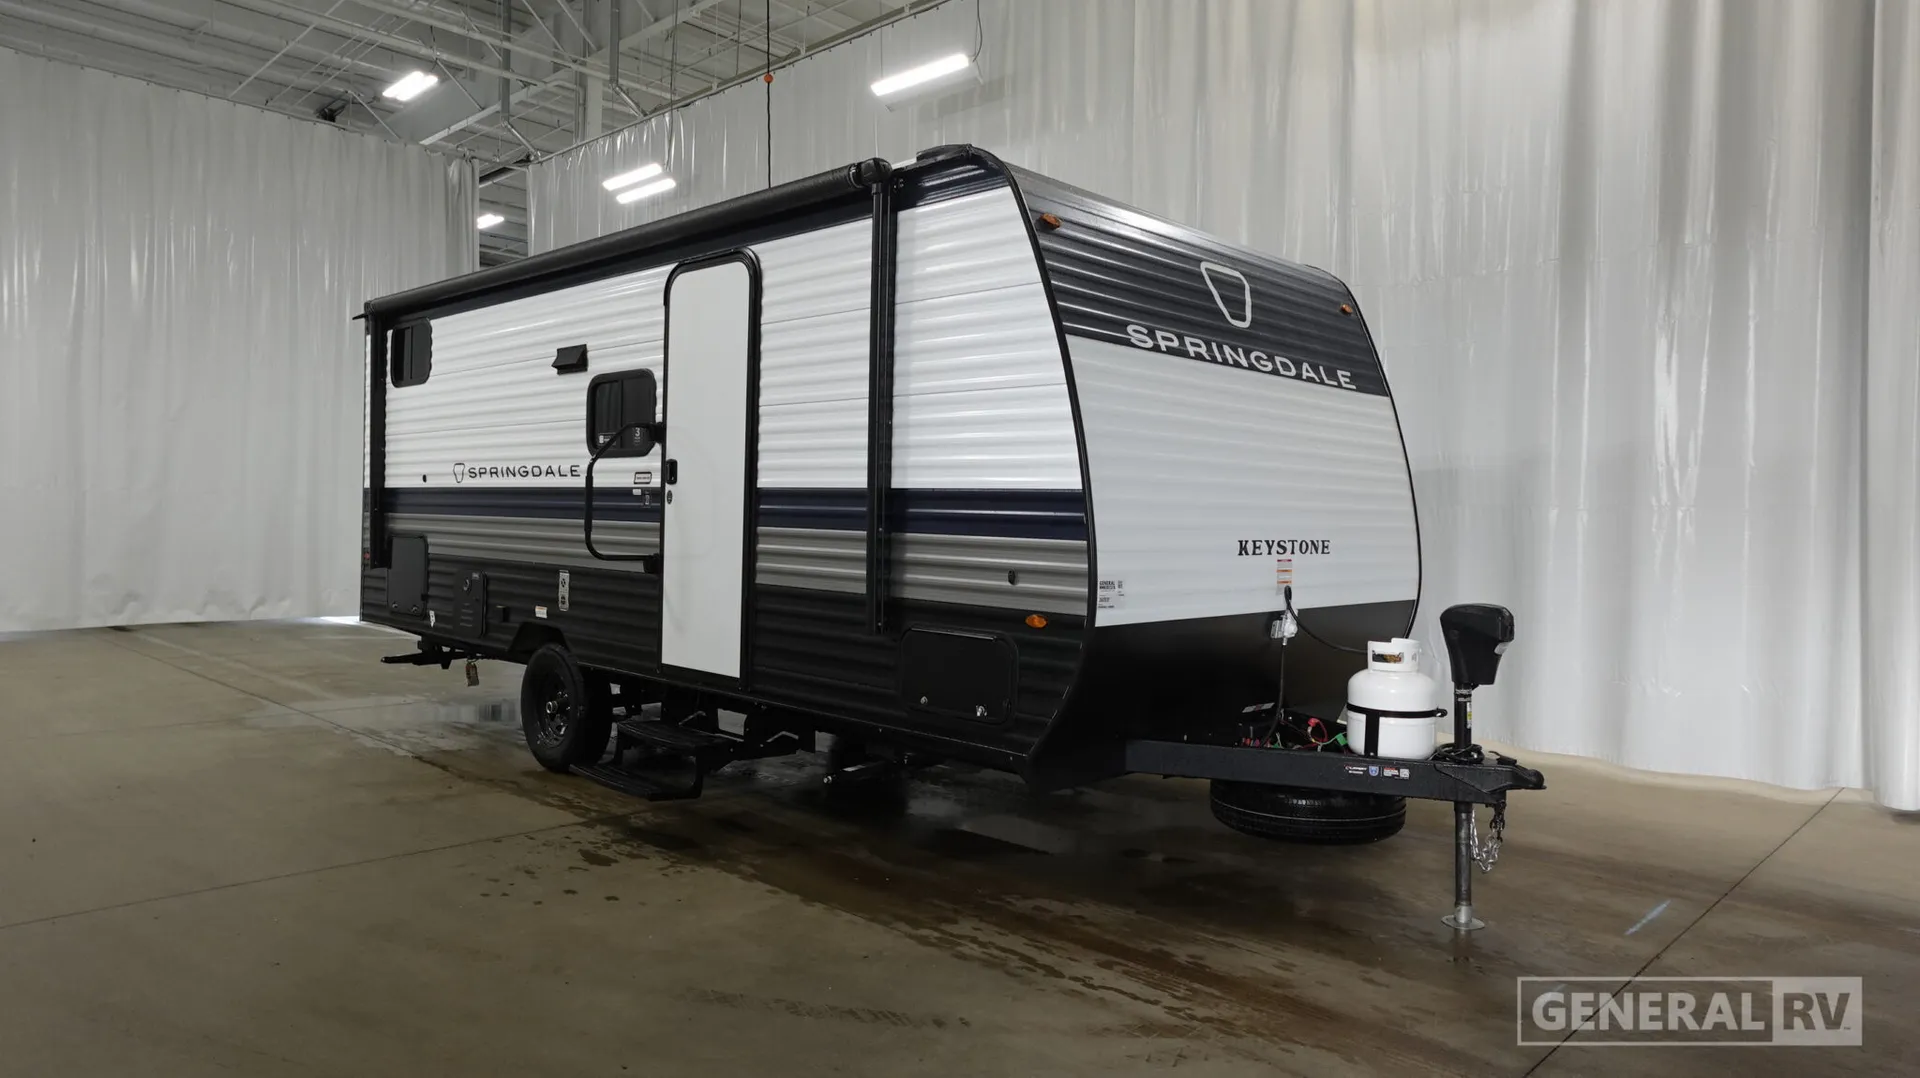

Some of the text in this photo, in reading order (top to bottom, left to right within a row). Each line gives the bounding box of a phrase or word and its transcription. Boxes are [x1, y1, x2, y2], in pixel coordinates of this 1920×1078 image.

[1126, 324, 1357, 390] SPRINGDALE
[468, 464, 581, 479] SPRINGDALE
[1237, 539, 1331, 556] KEYSTONE
